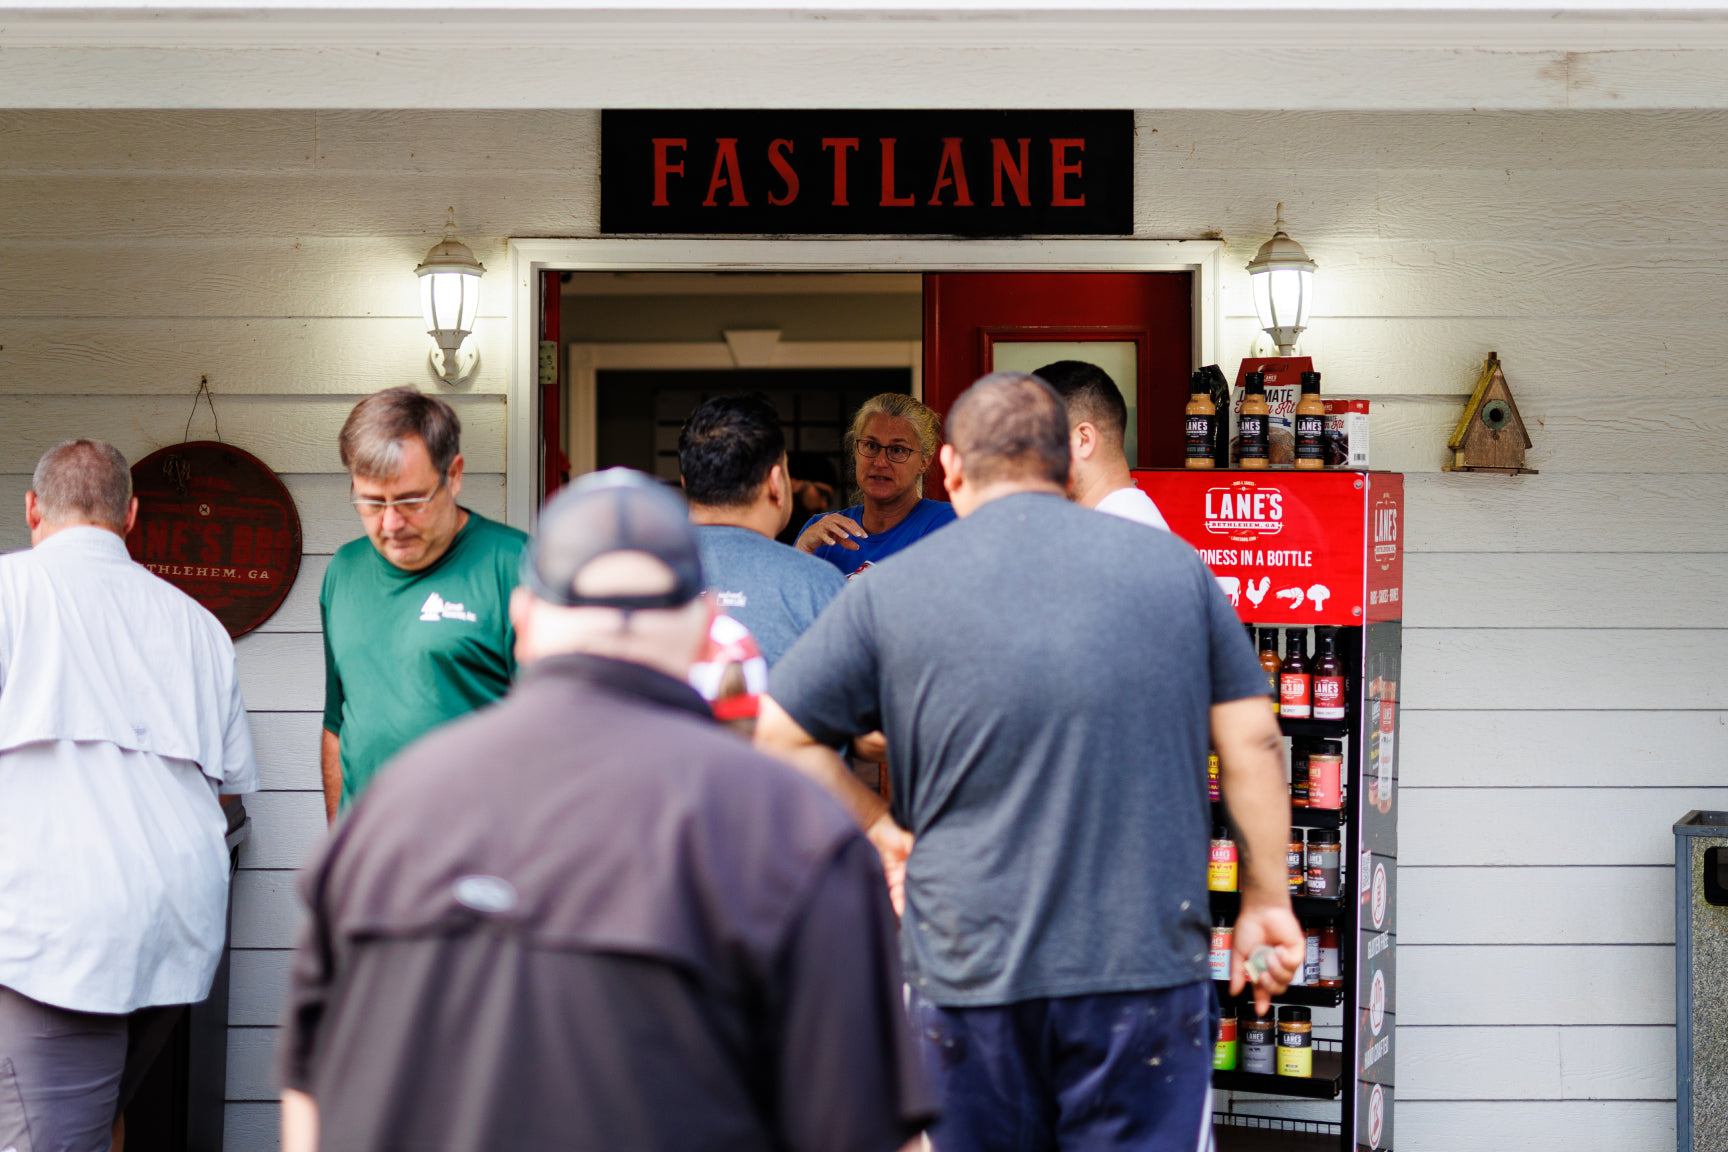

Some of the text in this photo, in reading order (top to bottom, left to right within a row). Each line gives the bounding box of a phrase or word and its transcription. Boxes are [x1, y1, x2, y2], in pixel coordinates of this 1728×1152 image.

[651, 137, 1087, 207] FASTLANE
[1205, 493, 1283, 520] LANE'S
[1374, 508, 1398, 542] LANE'S
[127, 520, 291, 571] ANE'S BBQ
[1240, 550, 1253, 566] IN
[1255, 550, 1264, 566] A
[1267, 550, 1313, 567] BOTTLE
[247, 569, 271, 579] GA
